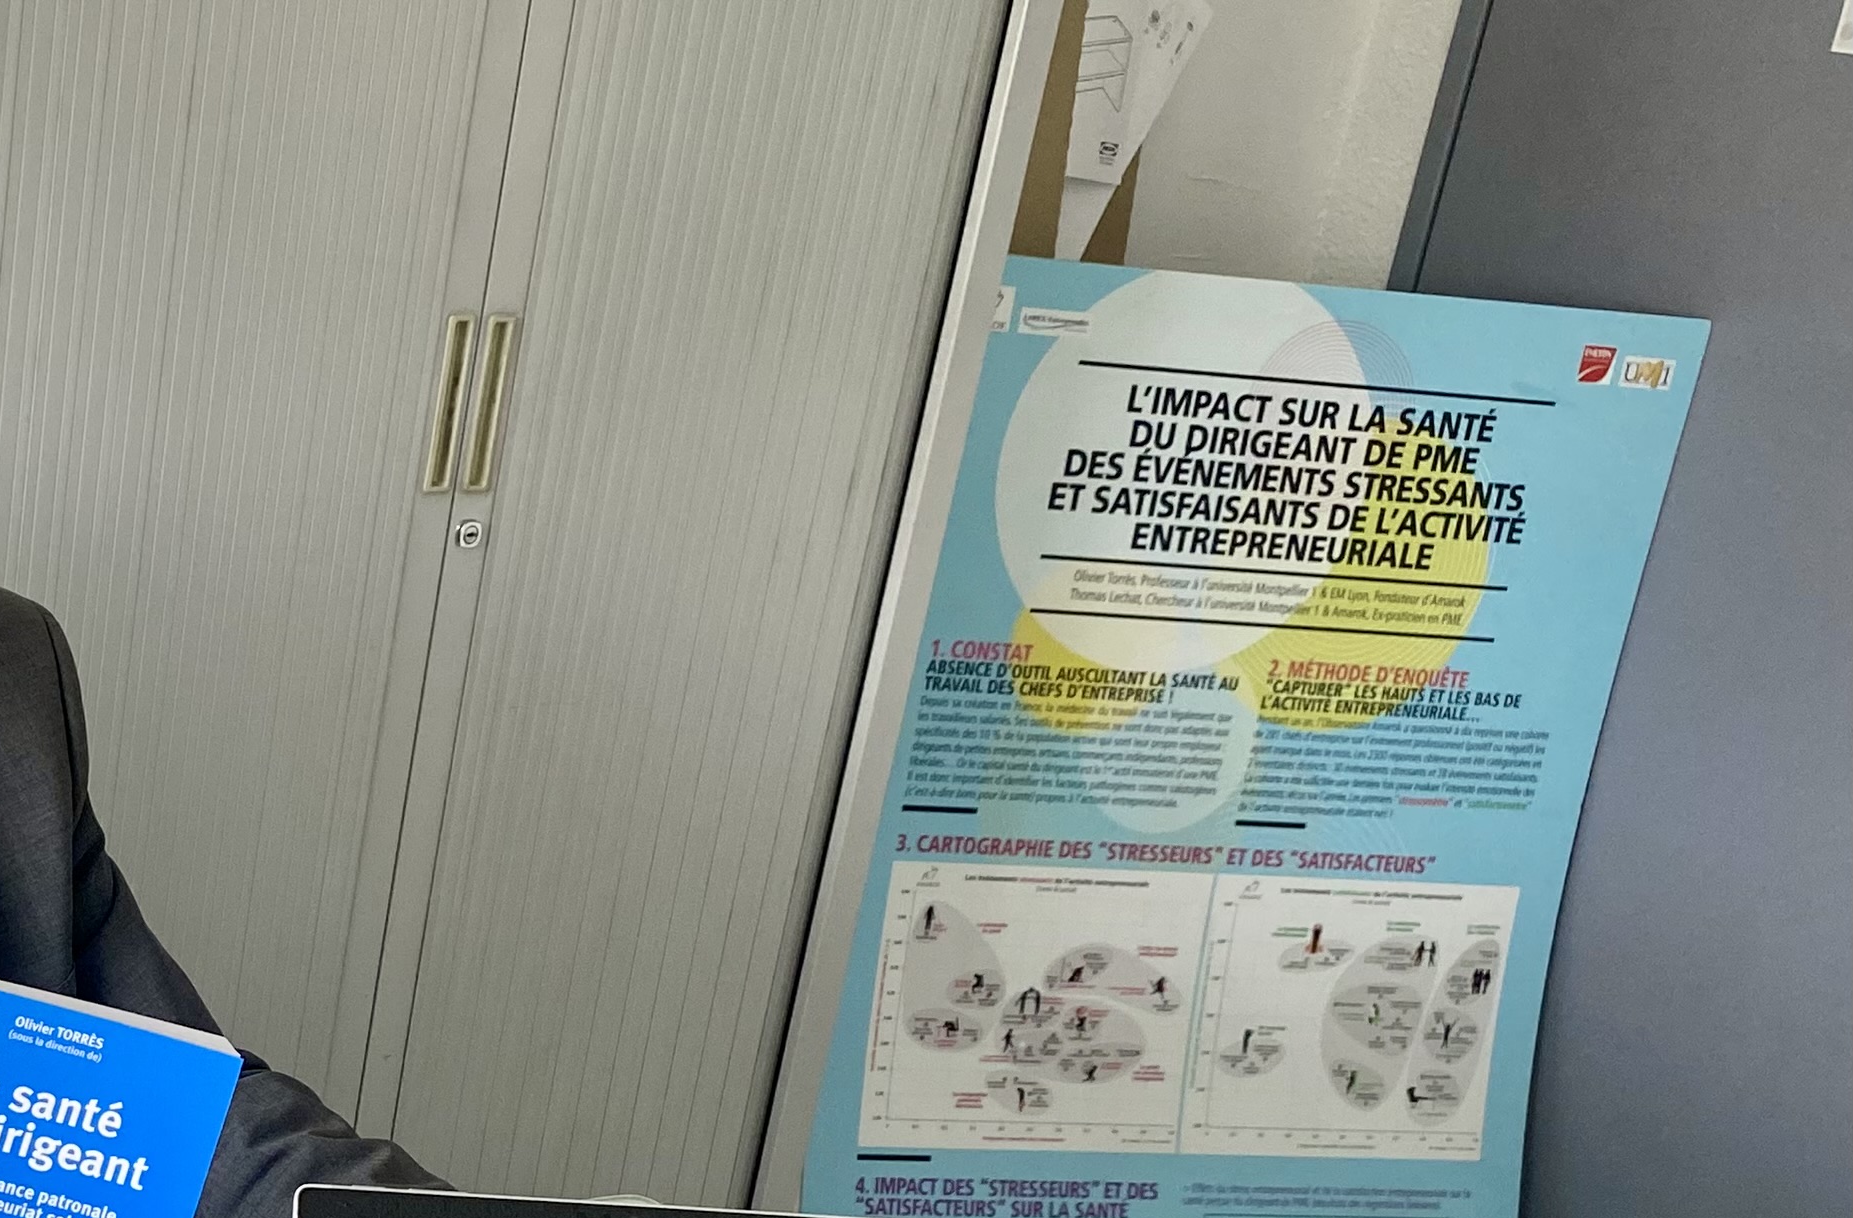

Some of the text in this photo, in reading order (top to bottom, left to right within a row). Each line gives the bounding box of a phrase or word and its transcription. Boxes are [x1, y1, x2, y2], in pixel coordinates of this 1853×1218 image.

[1127, 385, 1497, 443] L'IMPACT SUR LA SANTÉ
[1129, 420, 1480, 475] DU DIRIGEANT DE PME
[1064, 449, 1526, 511] DES ÉVÉNEMENTS STRESSANTS
[1048, 483, 1527, 546] ET SATISFAISANTS DE L'ACTIVITÉ
[1131, 523, 1435, 571] ENTREPRENEURIALE
[951, 640, 1034, 662] CONSTAT
[924, 676, 1165, 704] TRAVAIL DES CHEFS D'ENTREPRISE
[926, 660, 1239, 691] ABSENCE D'OUTIL AUSCULTANT LA SANTÉ AU
[1287, 660, 1470, 690] MÉTHODE D'ENQUÊTE
[1260, 693, 1331, 714] L'ACTIVITÉ
[1353, 685, 1378, 699] LES
[1381, 686, 1425, 702] HAUTS
[1428, 689, 1446, 704] ET
[1448, 690, 1470, 706] LES
[1474, 692, 1501, 708] BAS
[1503, 694, 1522, 709] DE
[917, 834, 1054, 858] CARTOGRAPHIE
[1059, 841, 1093, 859] DES
[1227, 848, 1245, 866] ET
[1252, 849, 1283, 868] DES
[7, 1028, 104, 1063] (sous la direction de)
[14, 1014, 105, 1051] Olivier TORRÈS
[8, 1086, 123, 1138] santé
[874, 1178, 940, 1197] IMPACT
[943, 1178, 975, 1197] DES
[1103, 1181, 1125, 1199] ET
[1127, 1182, 1159, 1200] DES
[1010, 1201, 1044, 1218] SUR
[1049, 1202, 1070, 1218] LA
